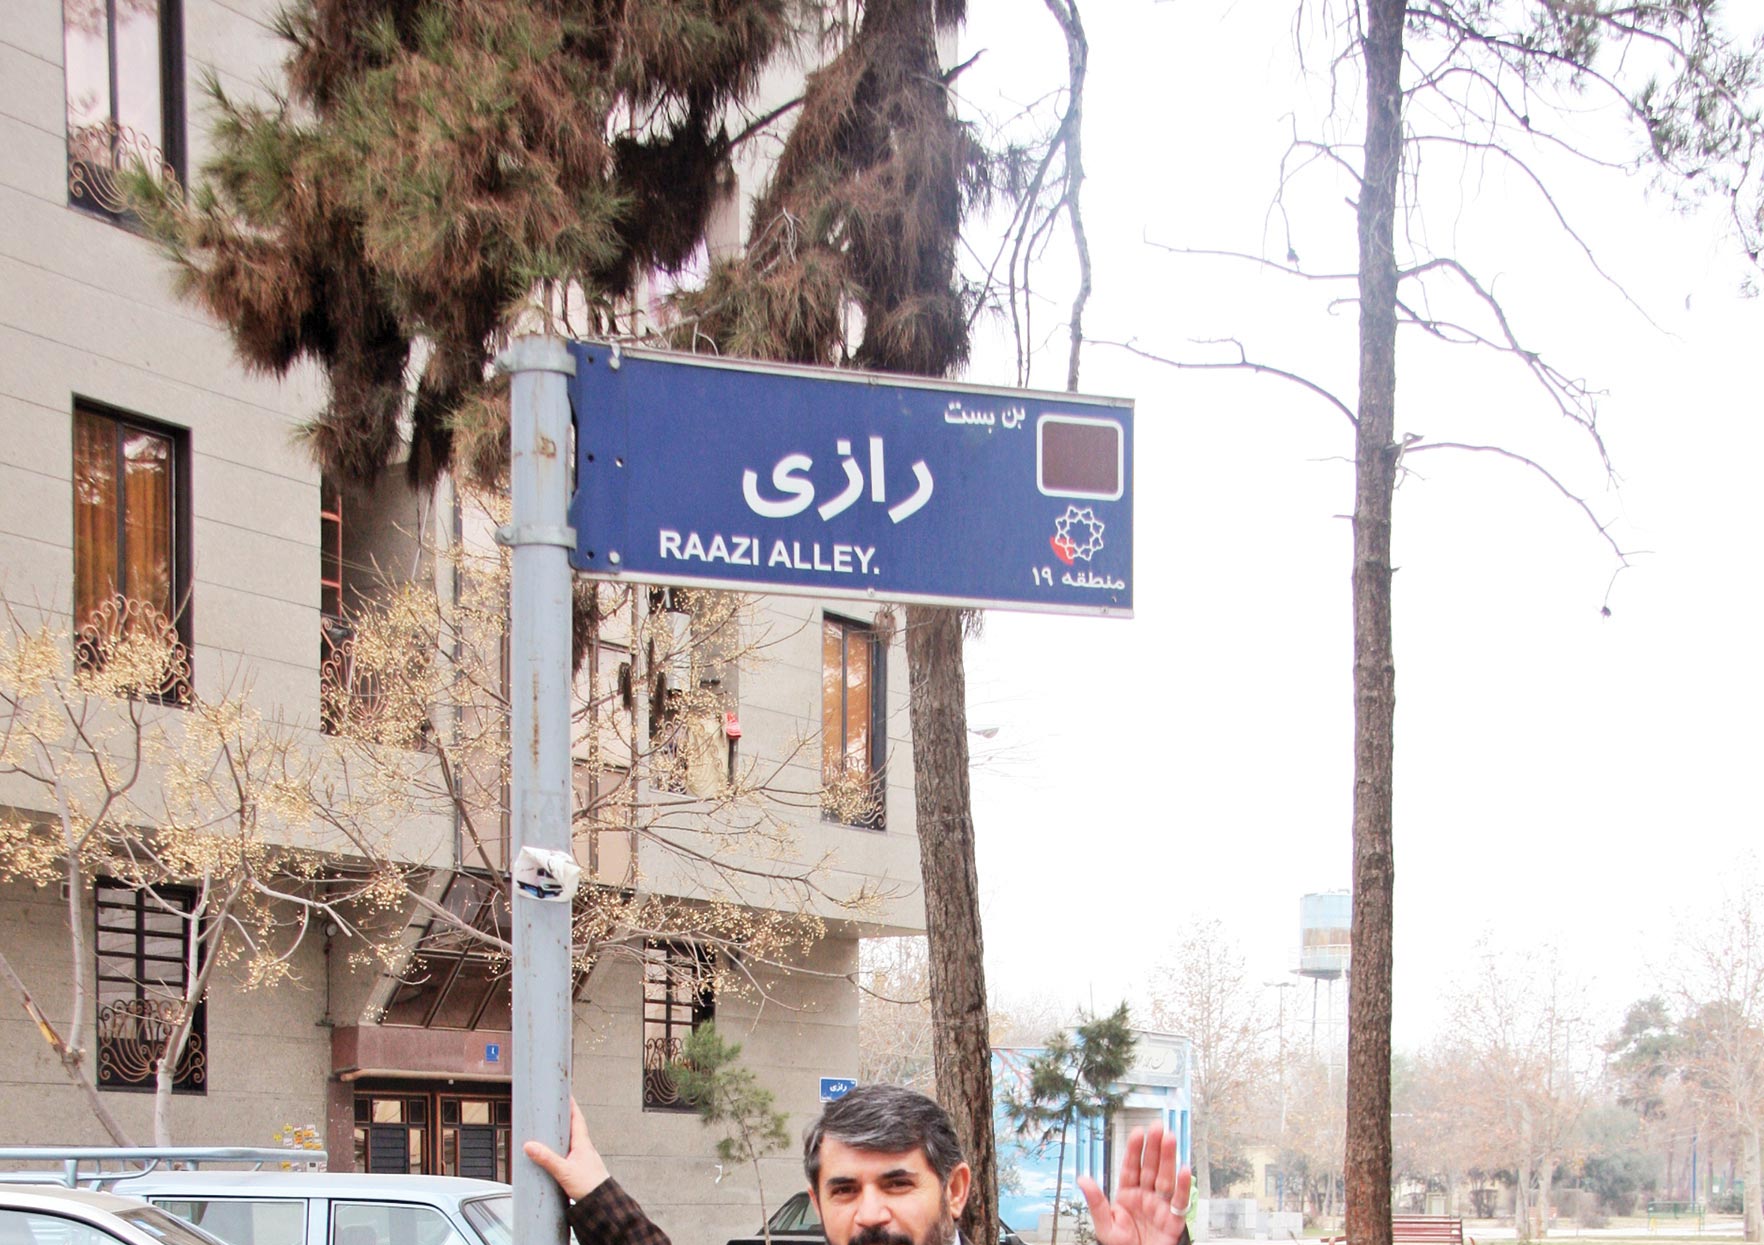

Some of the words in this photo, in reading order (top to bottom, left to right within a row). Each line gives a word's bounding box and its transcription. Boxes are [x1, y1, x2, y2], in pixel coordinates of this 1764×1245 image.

[944, 401, 996, 434] بست
[1001, 406, 1026, 430] بن
[742, 436, 934, 524] رازی
[659, 529, 759, 566] RAAZI
[768, 539, 880, 575] ALLEY.
[1031, 566, 1054, 587] ۱۹
[1061, 570, 1126, 590] منطقه
